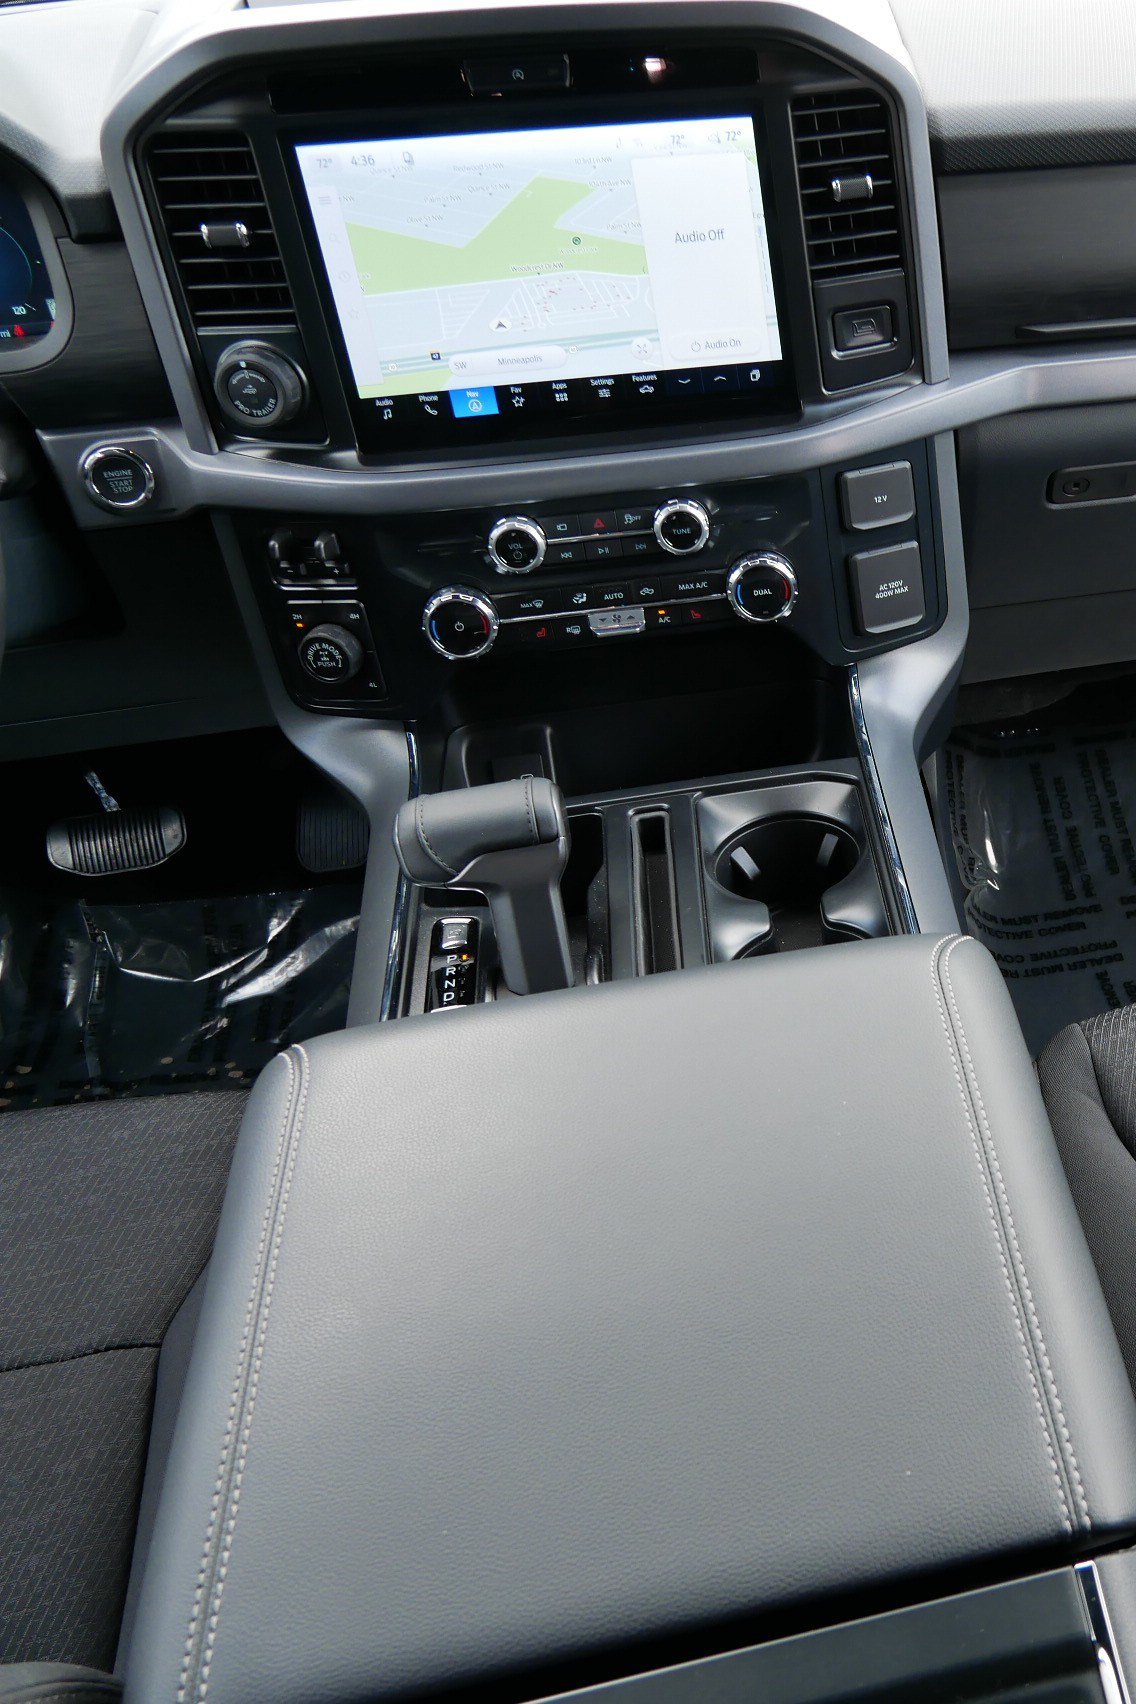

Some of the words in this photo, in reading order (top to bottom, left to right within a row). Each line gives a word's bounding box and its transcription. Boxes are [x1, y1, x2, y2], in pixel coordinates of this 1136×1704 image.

[351, 155, 375, 167] 4:36
[674, 231, 706, 244] Audio
[708, 229, 725, 241] Off
[12, 305, 27, 316] 120
[704, 340, 728, 350] Audio
[730, 338, 742, 348] On
[454, 360, 467, 370] SW
[497, 354, 543, 367] Minneapolis
[590, 376, 614, 387] Settings
[632, 374, 658, 382] Features
[510, 386, 522, 394] Fav
[552, 382, 568, 391] Apps
[418, 394, 438, 403] Phone
[466, 390, 479, 398] Nav
[234, 400, 250, 414] PRO
[252, 398, 276, 416] TRAILER
[375, 398, 394, 407] Audio
[102, 469, 133, 478] ENGINE
[110, 479, 133, 487] START
[113, 486, 133, 494] STOP
[678, 583, 694, 591] MAX
[695, 581, 709, 590] A/C
[888, 580, 903, 589] 120V
[604, 592, 624, 600] AUTO
[753, 588, 773, 596] DUAL
[874, 590, 894, 599] 400W
[894, 586, 908, 595] MAX
[658, 616, 671, 624] A/C
[308, 642, 321, 660] DRIVE
[322, 643, 342, 660] MODE
[1000, 914, 1040, 927] MUST
[1044, 903, 1104, 922] REMOVE
[1038, 921, 1088, 938] COVER
[1030, 940, 1118, 964] PROTECTIVE
[446, 955, 458, 964] P
[1068, 952, 1125, 973] DEALER
[446, 967, 456, 976] R
[1023, 962, 1065, 979] MUST
[444, 978, 456, 988] N
[443, 992, 455, 1002] D
